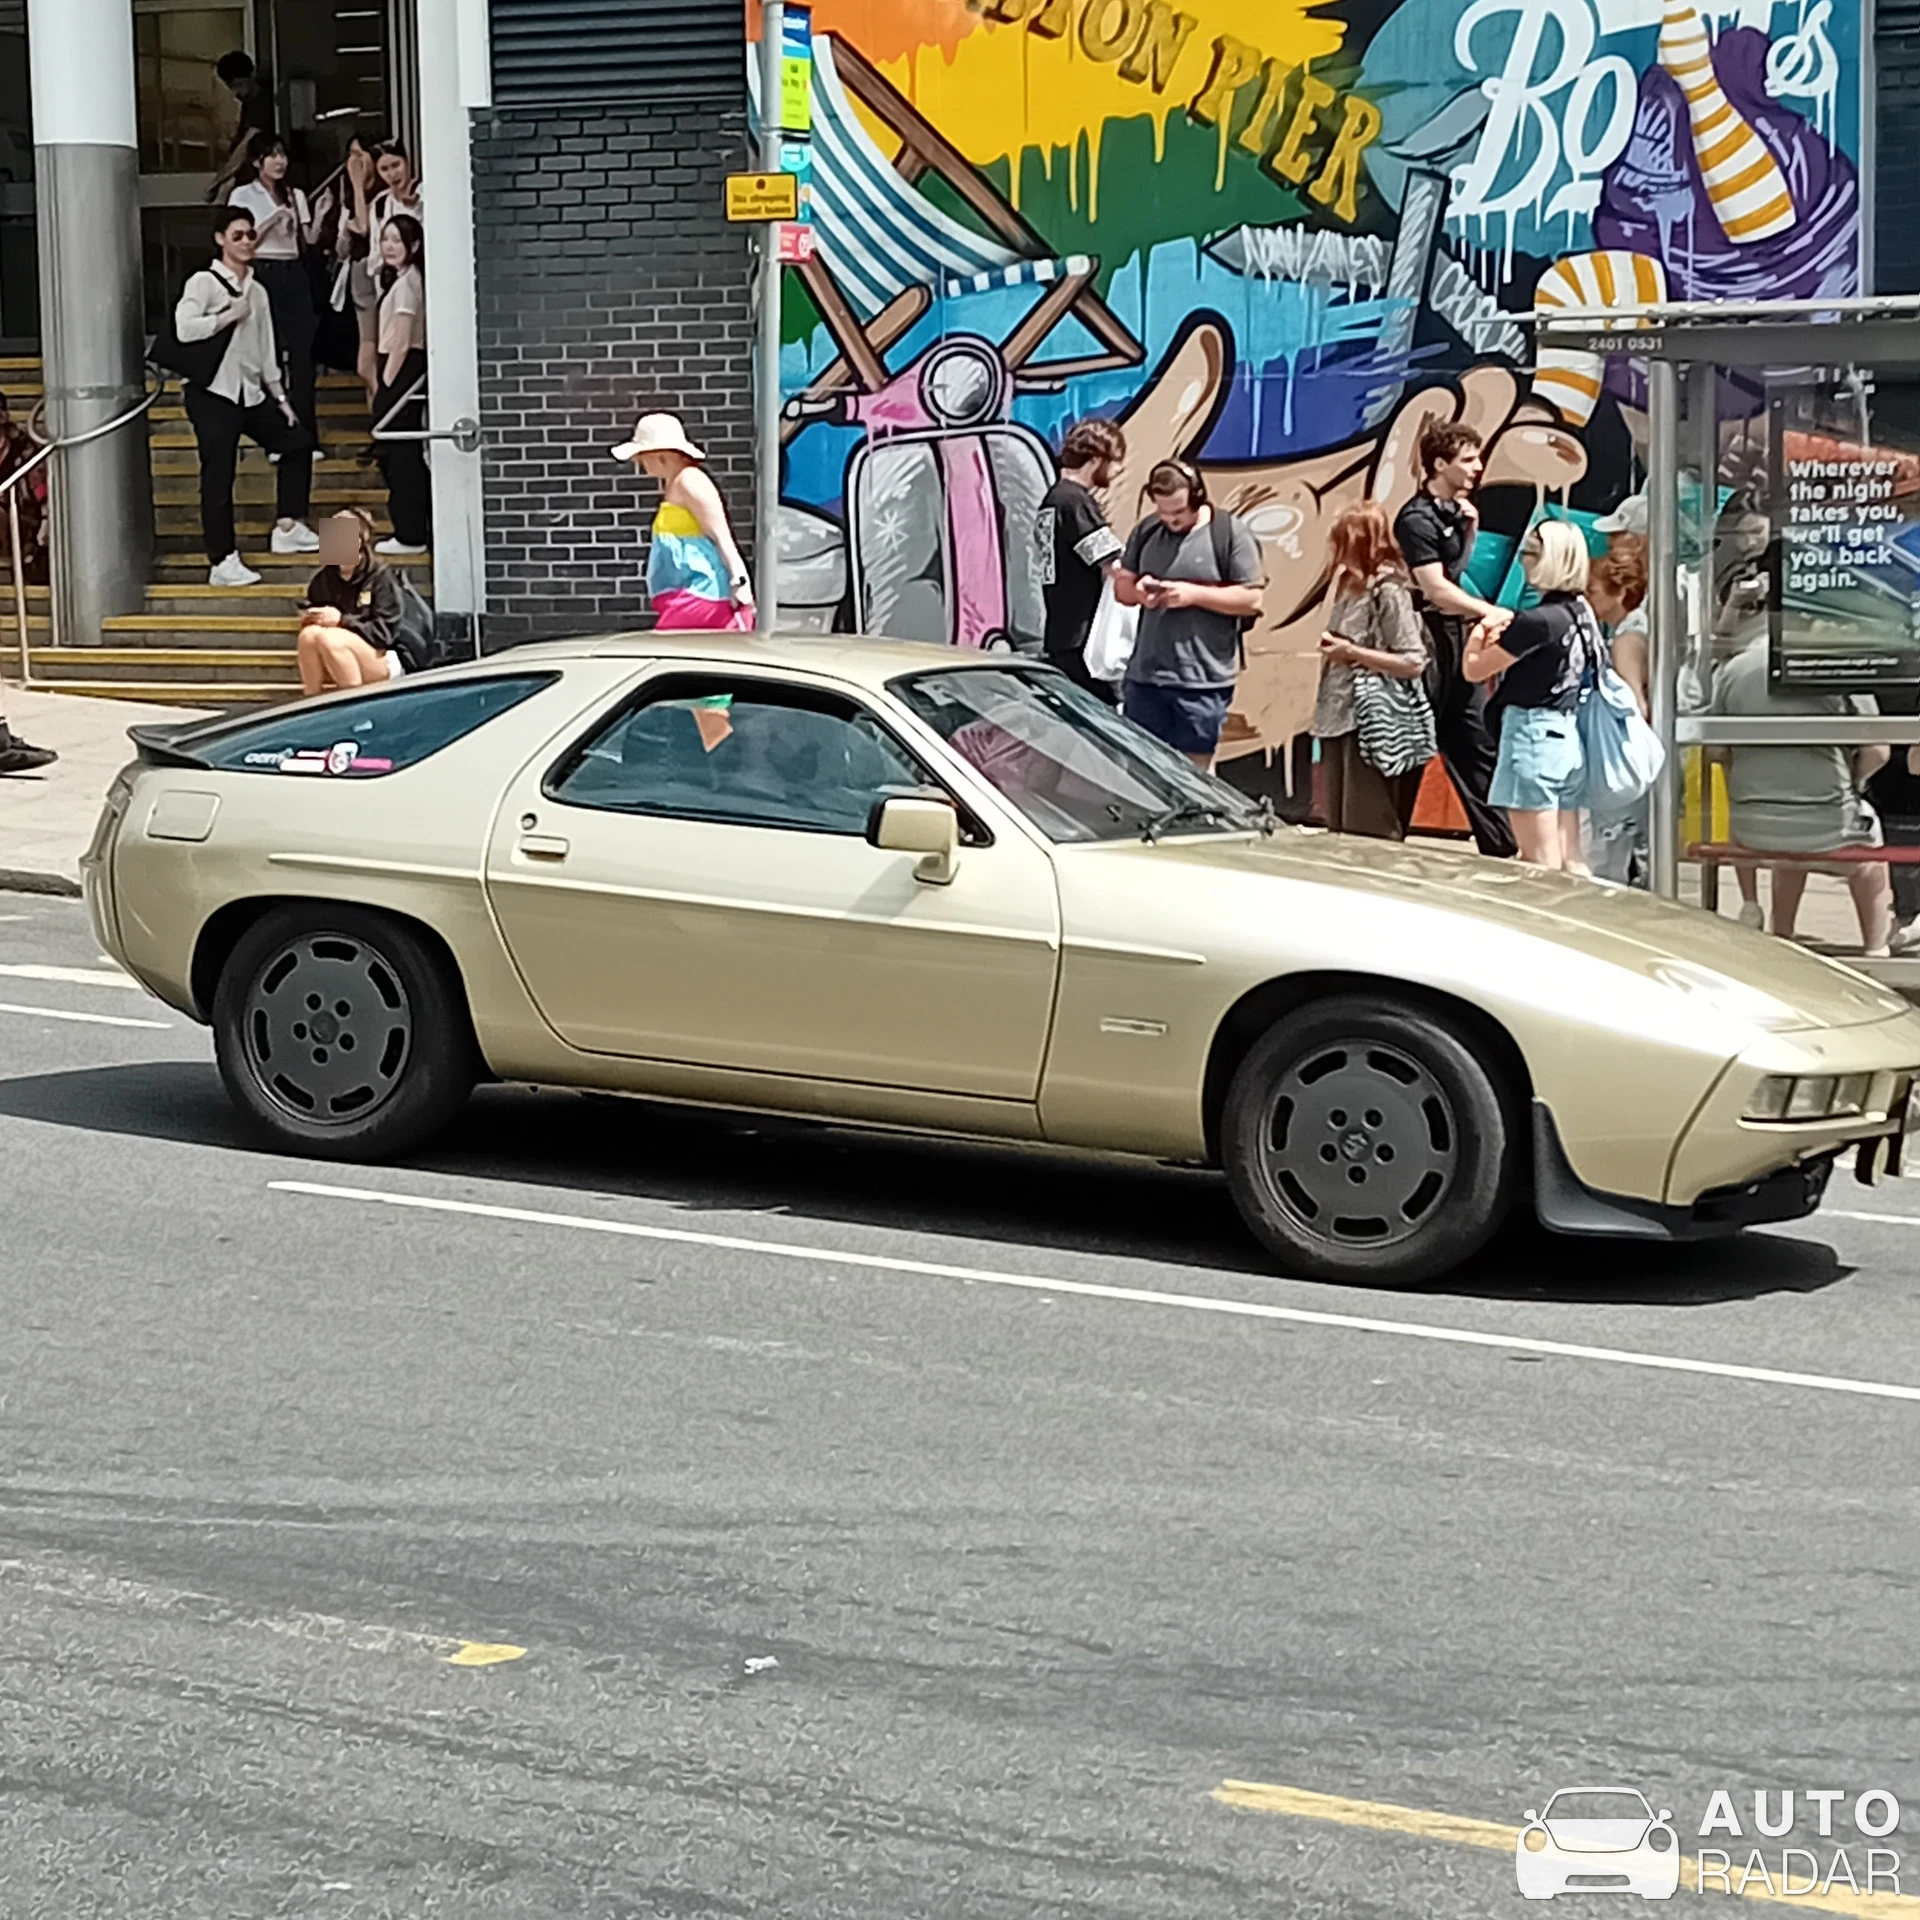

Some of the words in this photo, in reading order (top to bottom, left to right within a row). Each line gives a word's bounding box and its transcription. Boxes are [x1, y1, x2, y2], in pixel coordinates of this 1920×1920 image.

[1187, 33, 1382, 224] PIER
[1588, 337, 1623, 350] 2401
[1789, 459, 1898, 477] Wherever
[1789, 480, 1826, 501] the
[1832, 479, 1893, 503] night
[1789, 505, 1849, 523] takes
[1856, 504, 1905, 525] you,
[1847, 525, 1885, 547] get
[1790, 551, 1832, 571] you
[1840, 545, 1892, 565] back
[1789, 567, 1858, 592] again.
